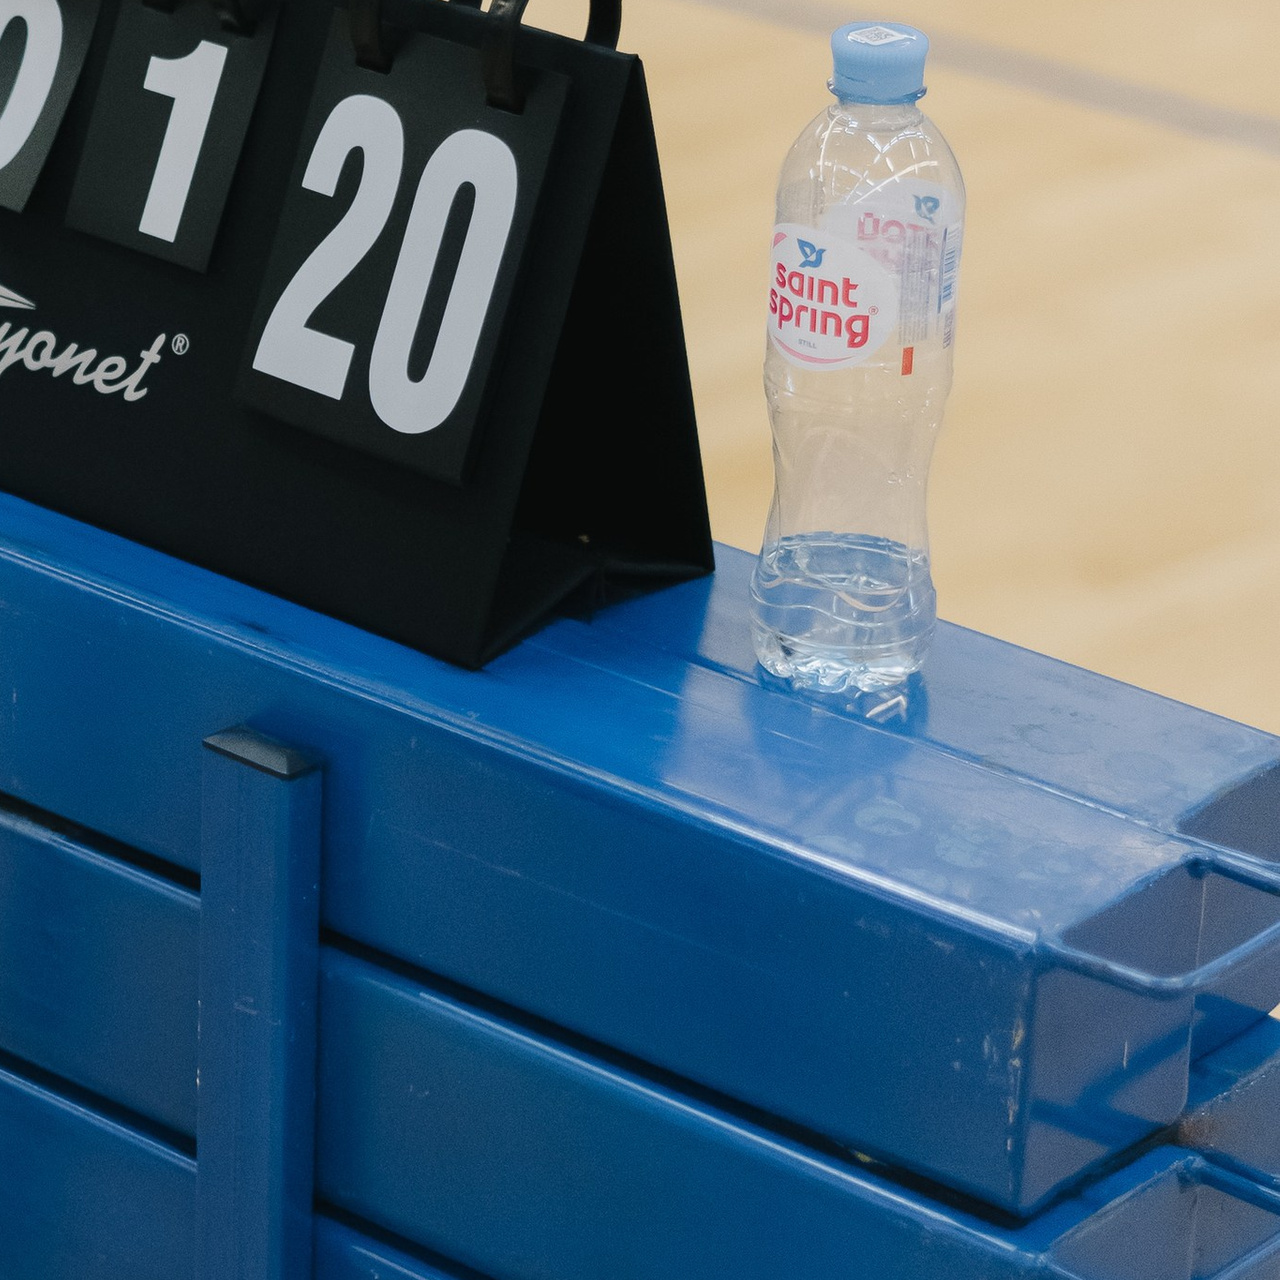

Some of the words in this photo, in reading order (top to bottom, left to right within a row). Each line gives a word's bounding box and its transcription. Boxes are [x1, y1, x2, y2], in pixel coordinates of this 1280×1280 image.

[138, 40, 228, 243] 1
[252, 94, 518, 434] 20
[775, 262, 859, 308] saint
